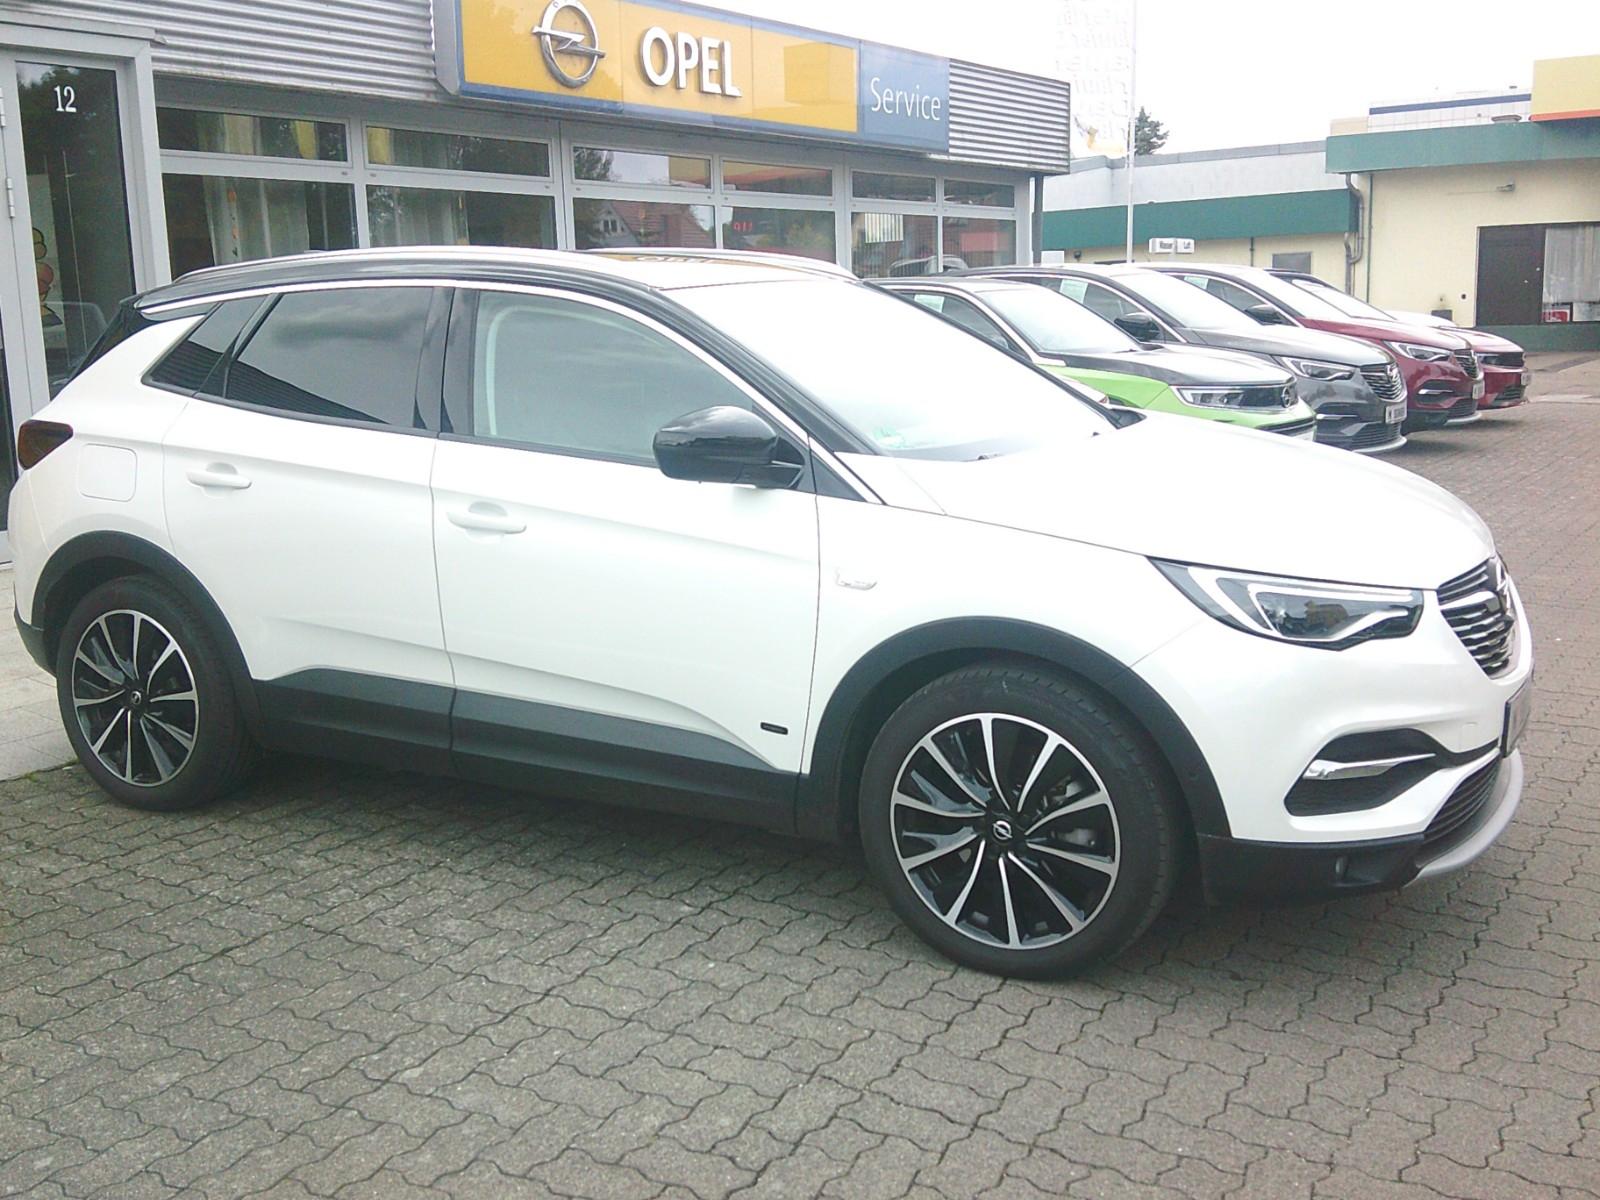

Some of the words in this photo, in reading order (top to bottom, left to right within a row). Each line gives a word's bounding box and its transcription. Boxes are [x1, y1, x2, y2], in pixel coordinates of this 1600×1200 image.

[640, 26, 743, 97] OPEL
[54, 85, 77, 113] 12
[870, 77, 941, 121] Service
